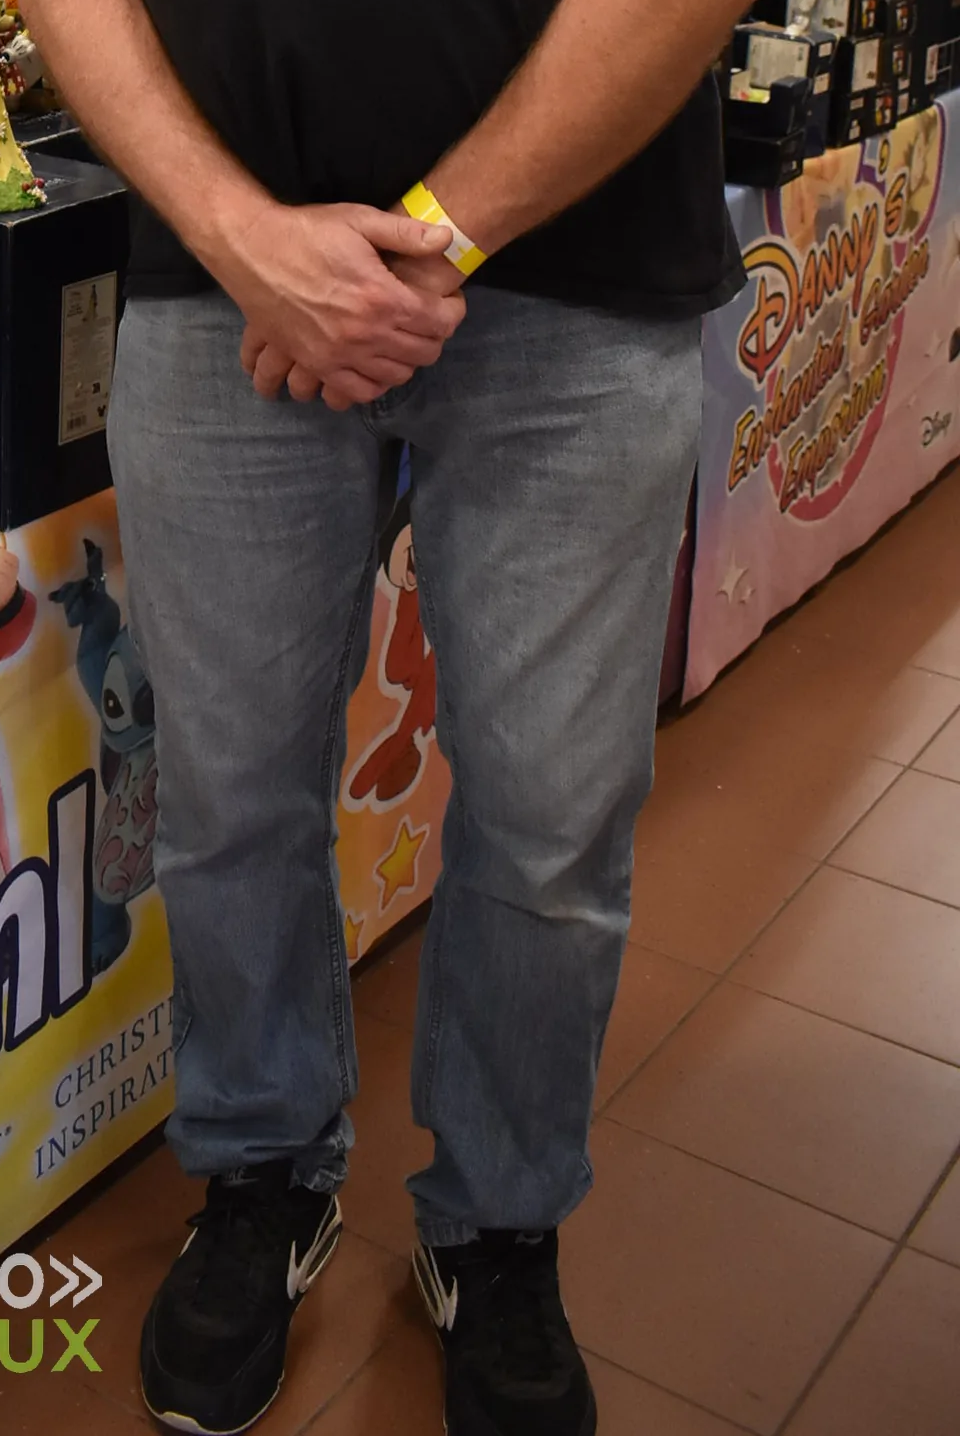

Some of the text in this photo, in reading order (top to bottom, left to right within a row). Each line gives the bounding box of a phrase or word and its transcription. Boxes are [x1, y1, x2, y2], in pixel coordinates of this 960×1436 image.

[728, 236, 930, 493] Enchanted Garden
[779, 358, 887, 513] Emporium
[34, 1046, 174, 1179] INSPIRAT
